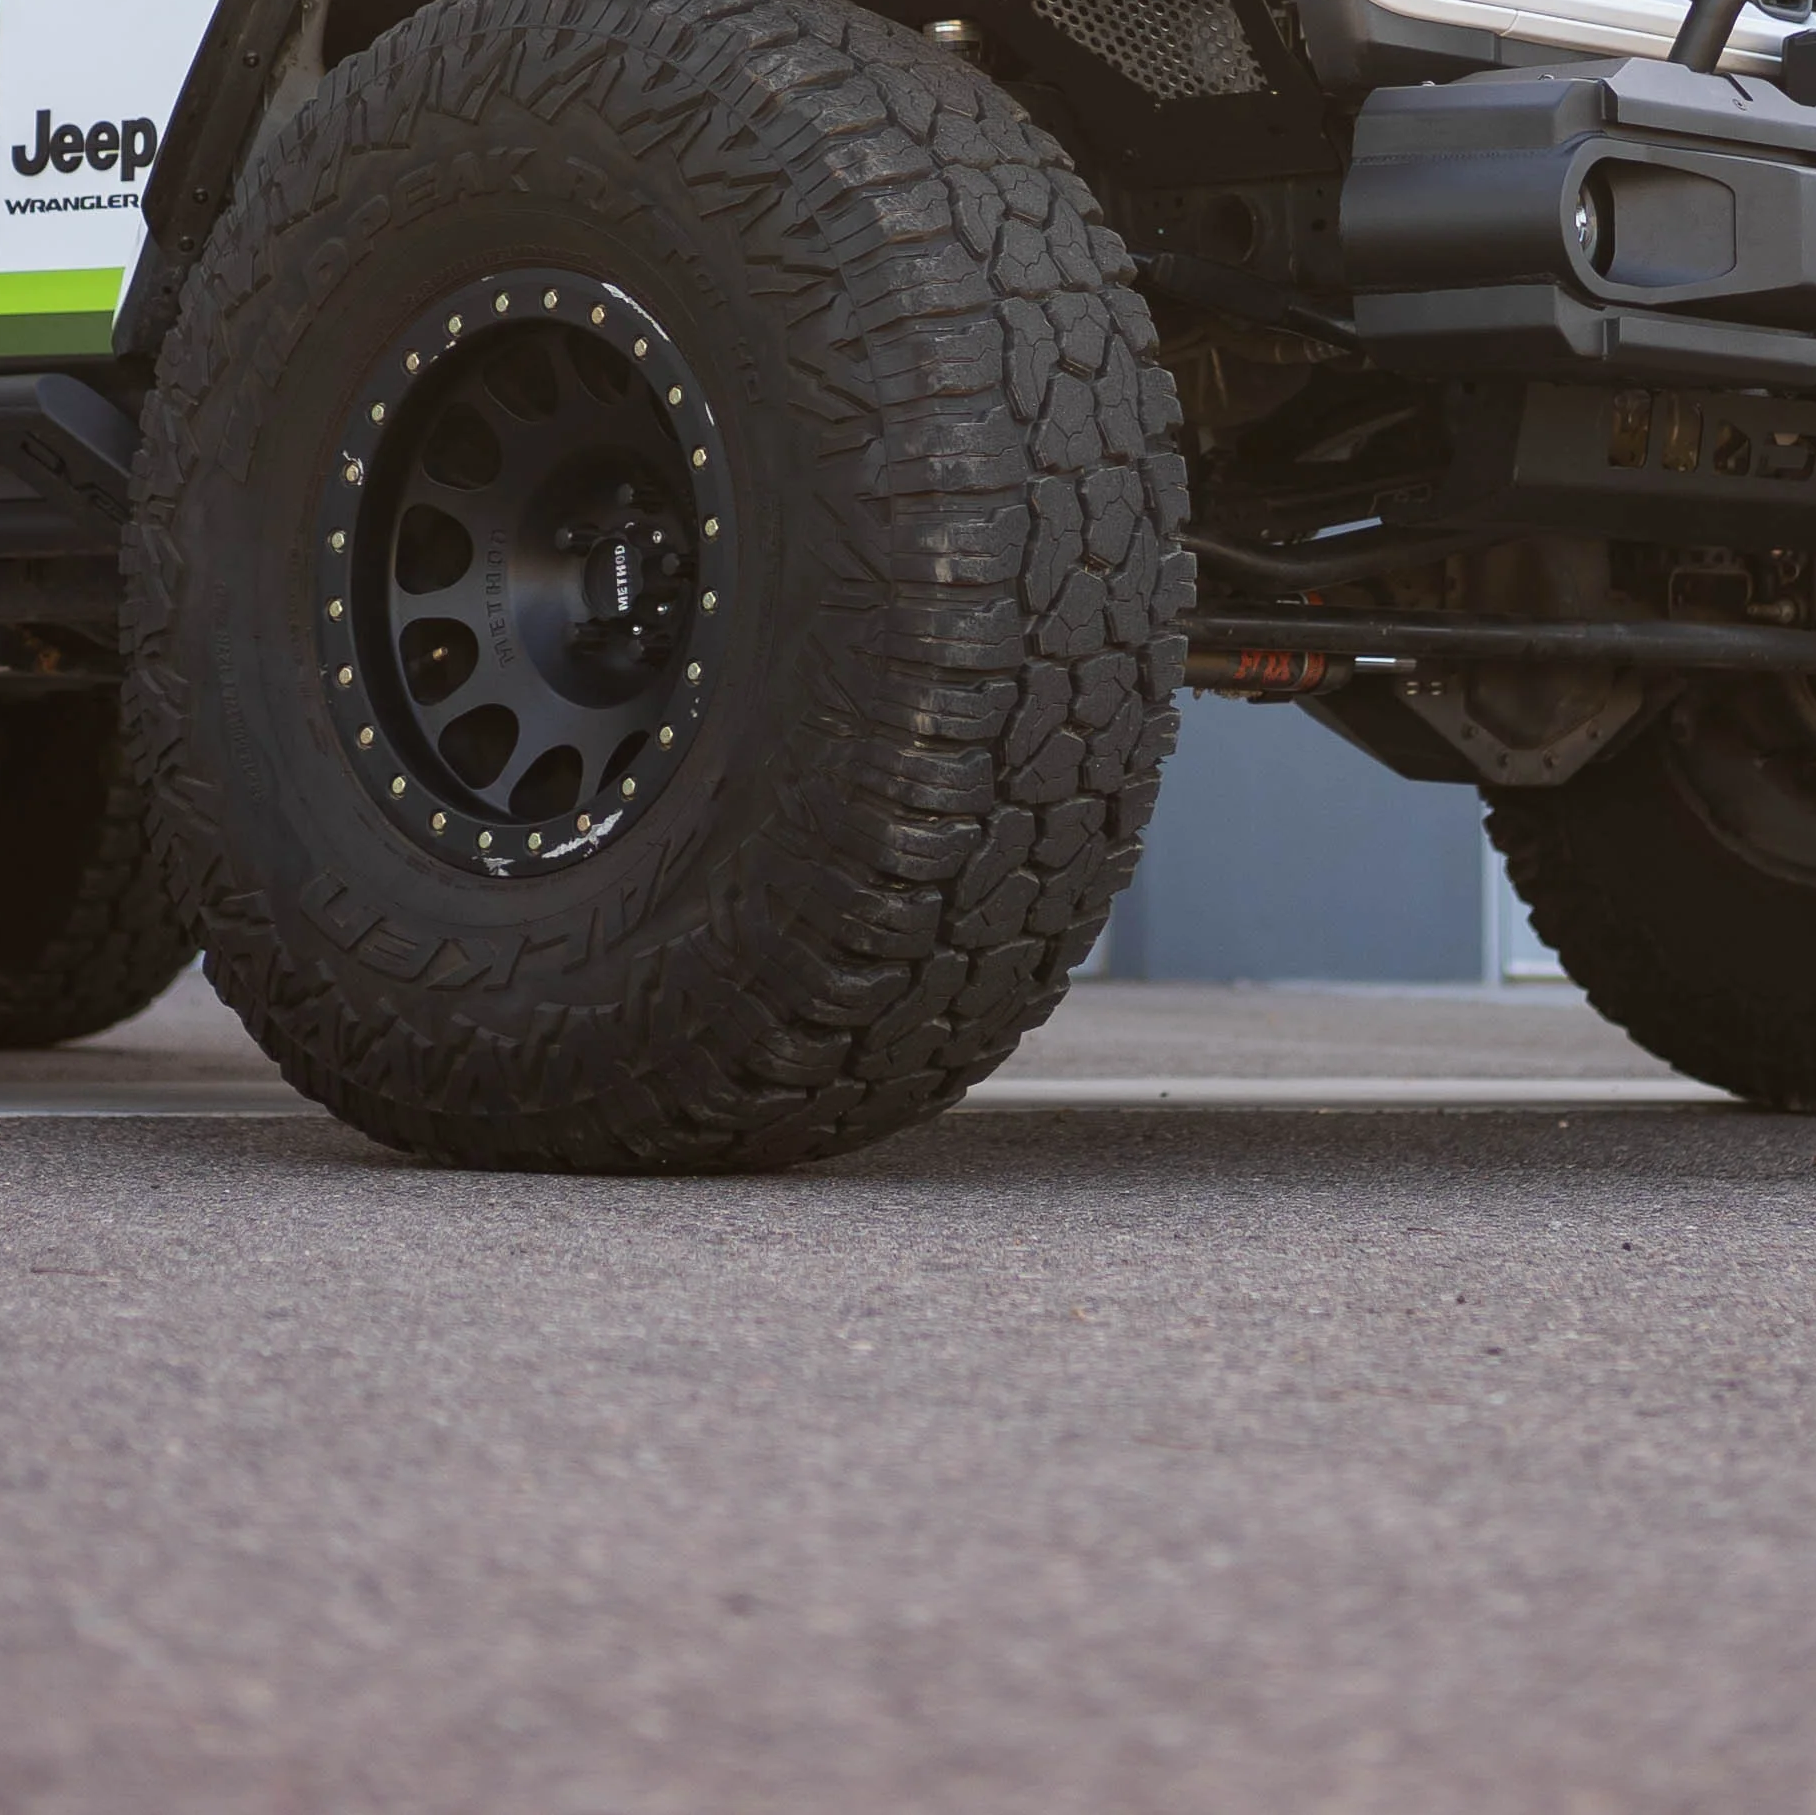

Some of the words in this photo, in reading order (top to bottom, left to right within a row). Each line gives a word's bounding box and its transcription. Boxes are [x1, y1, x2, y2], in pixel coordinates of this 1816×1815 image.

[11, 108, 158, 182] Jeep
[5, 193, 139, 215] WRANGLER
[485, 528, 515, 670] METHOD
[614, 544, 631, 614] METHOD
